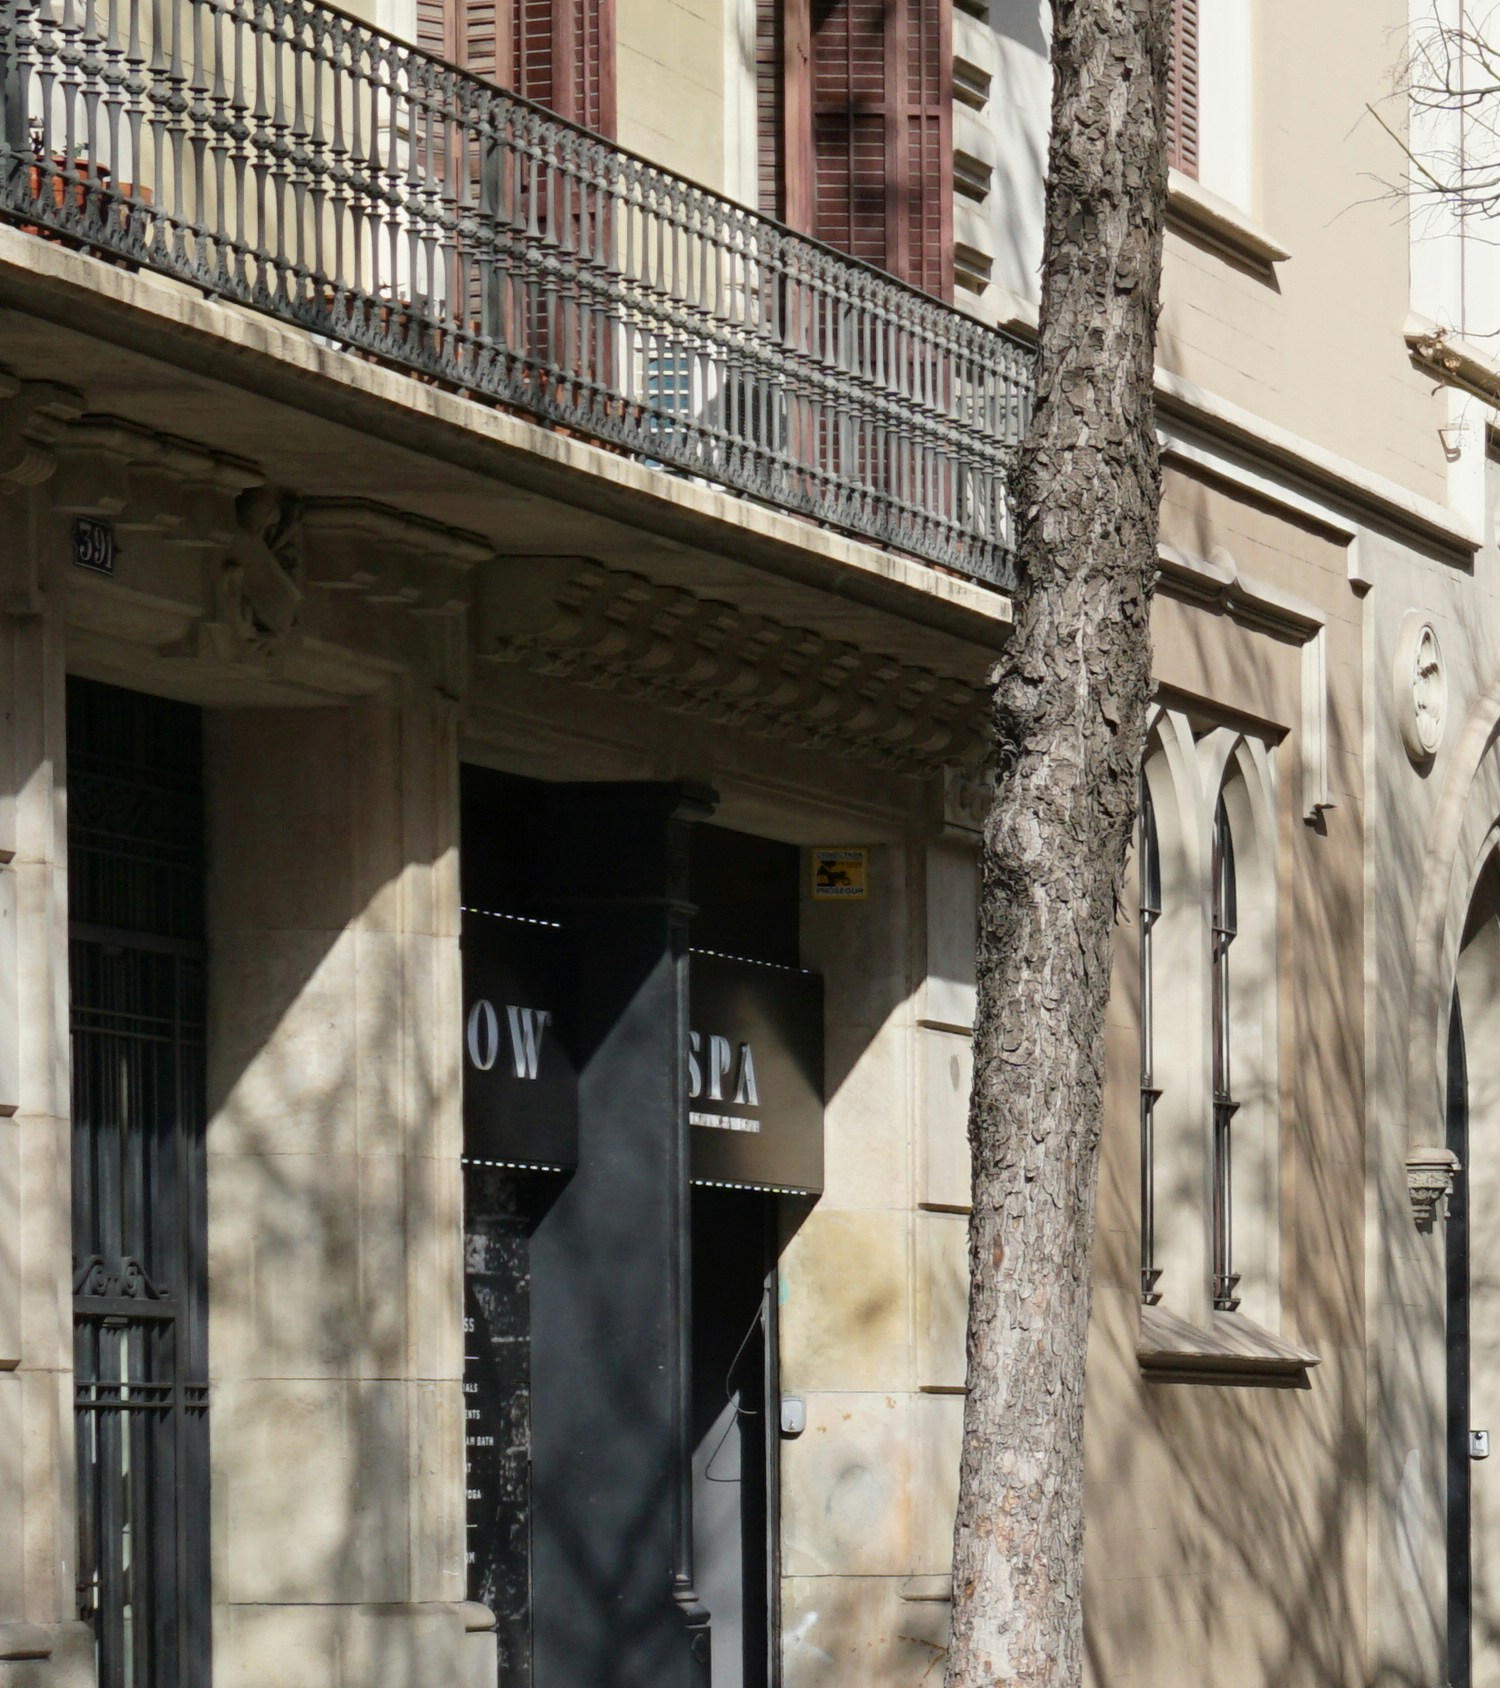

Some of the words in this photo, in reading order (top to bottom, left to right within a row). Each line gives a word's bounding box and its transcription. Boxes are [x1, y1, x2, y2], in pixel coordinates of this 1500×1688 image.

[78, 520, 112, 569] 391
[467, 999, 552, 1080] OW
[464, 1317, 475, 1333] SS
[463, 1383, 479, 1393] ALS
